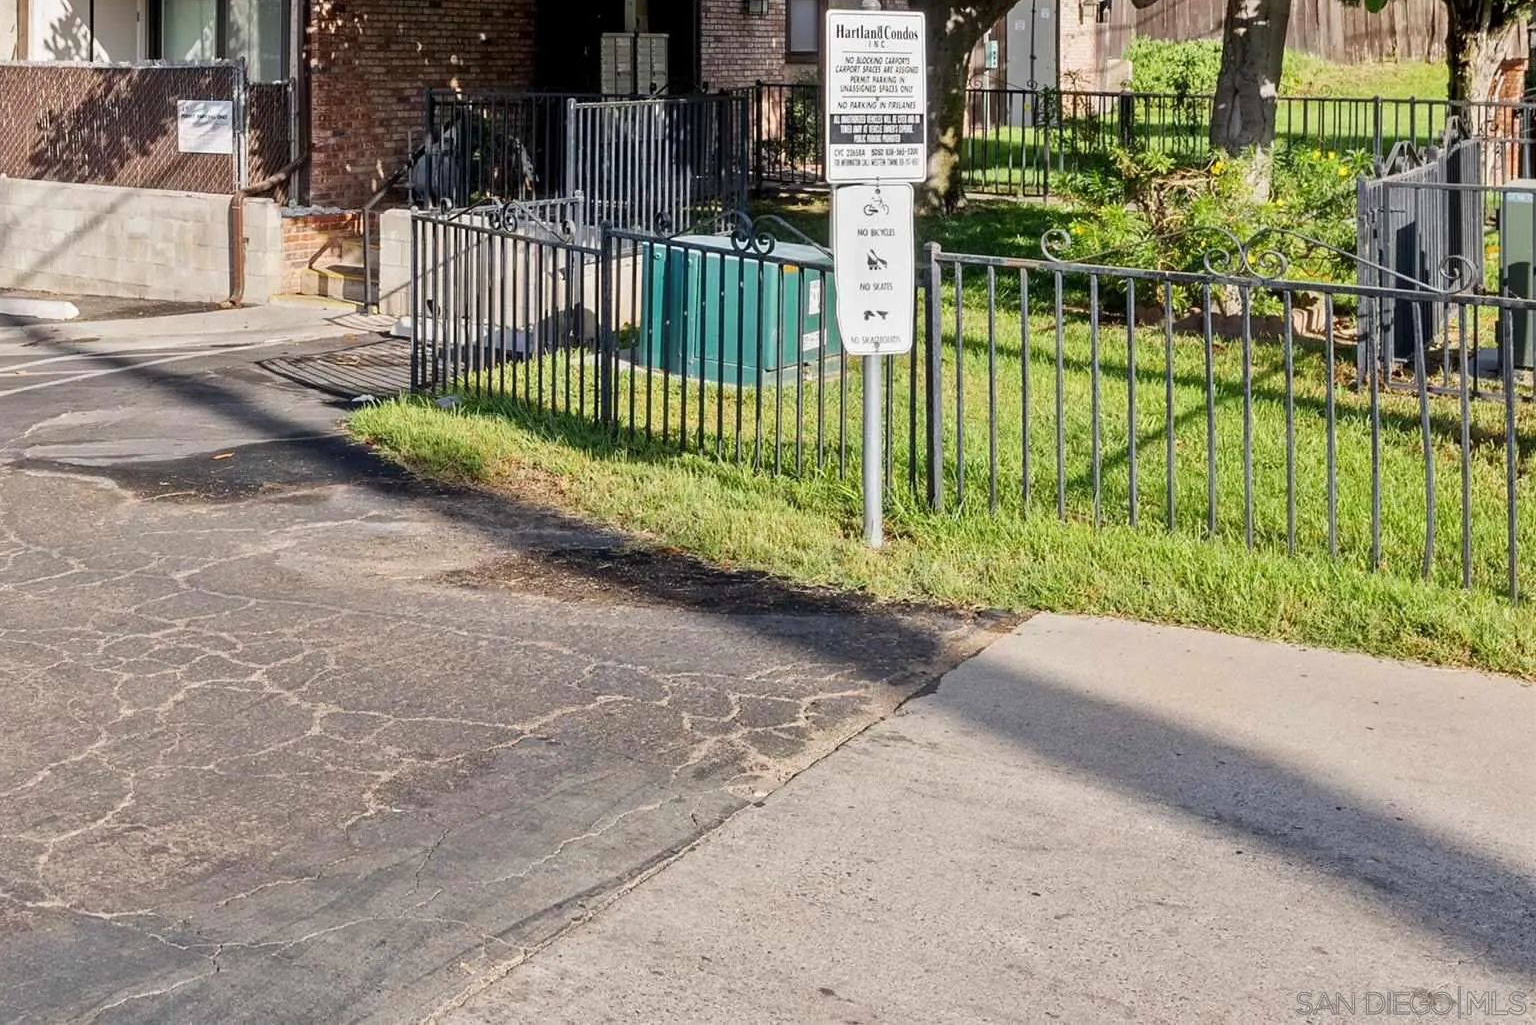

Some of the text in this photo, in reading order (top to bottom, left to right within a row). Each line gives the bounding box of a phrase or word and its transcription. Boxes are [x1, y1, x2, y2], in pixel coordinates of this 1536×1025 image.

[836, 24, 919, 41] Hartland Condos
[845, 56, 910, 65] NO BLOCKING CARPORTS
[835, 65, 919, 74] CARPORT SPACES ARE ASSIGNED
[873, 76, 897, 84] PARKING
[840, 85, 914, 93] UNASSIGNED SPACES ONLY
[838, 101, 848, 110] NO
[850, 101, 877, 110] PARKING
[879, 101, 886, 110] IN
[857, 228, 896, 237] NO BICYCLES
[859, 282, 893, 291] NO SKATES
